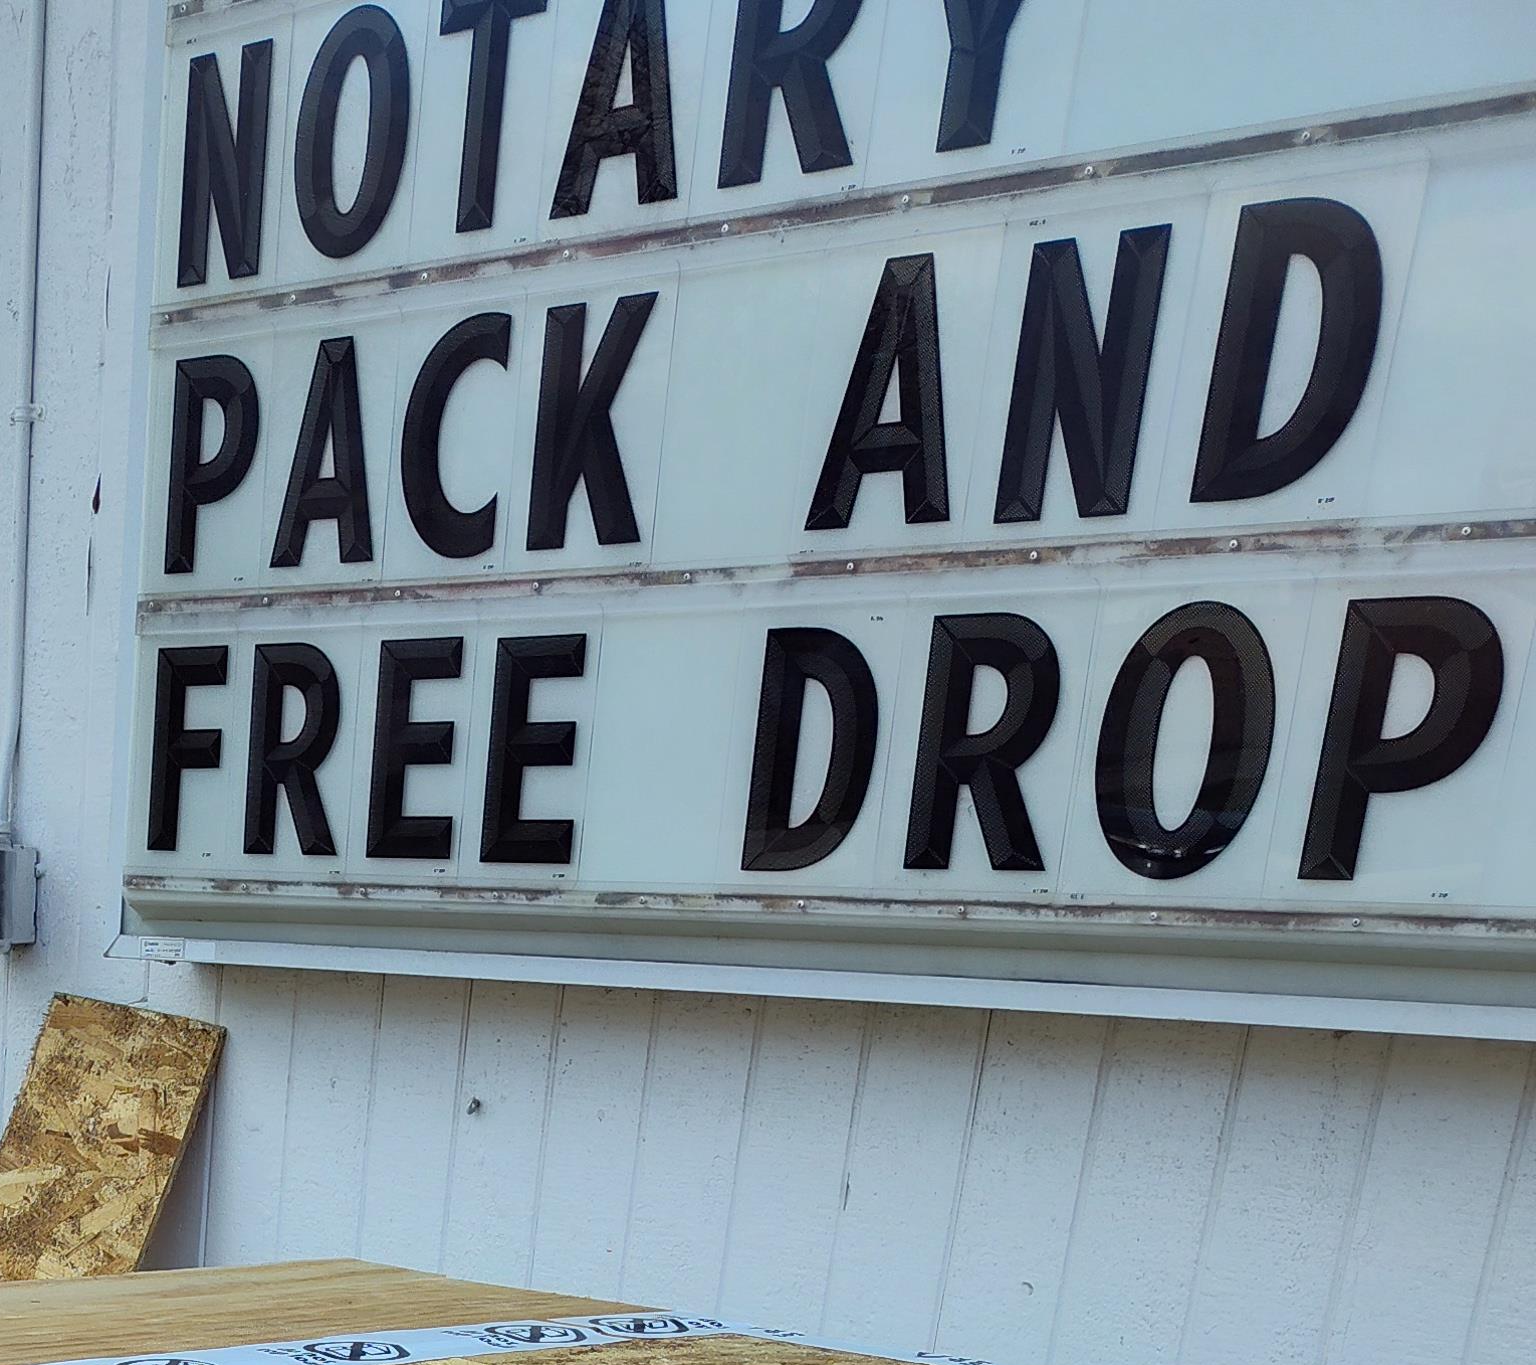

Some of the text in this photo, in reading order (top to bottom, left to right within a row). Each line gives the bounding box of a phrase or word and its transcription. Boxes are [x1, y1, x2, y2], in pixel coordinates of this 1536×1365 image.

[165, 197, 1382, 575] PACK AND
[148, 595, 1504, 881] FREE DROP
